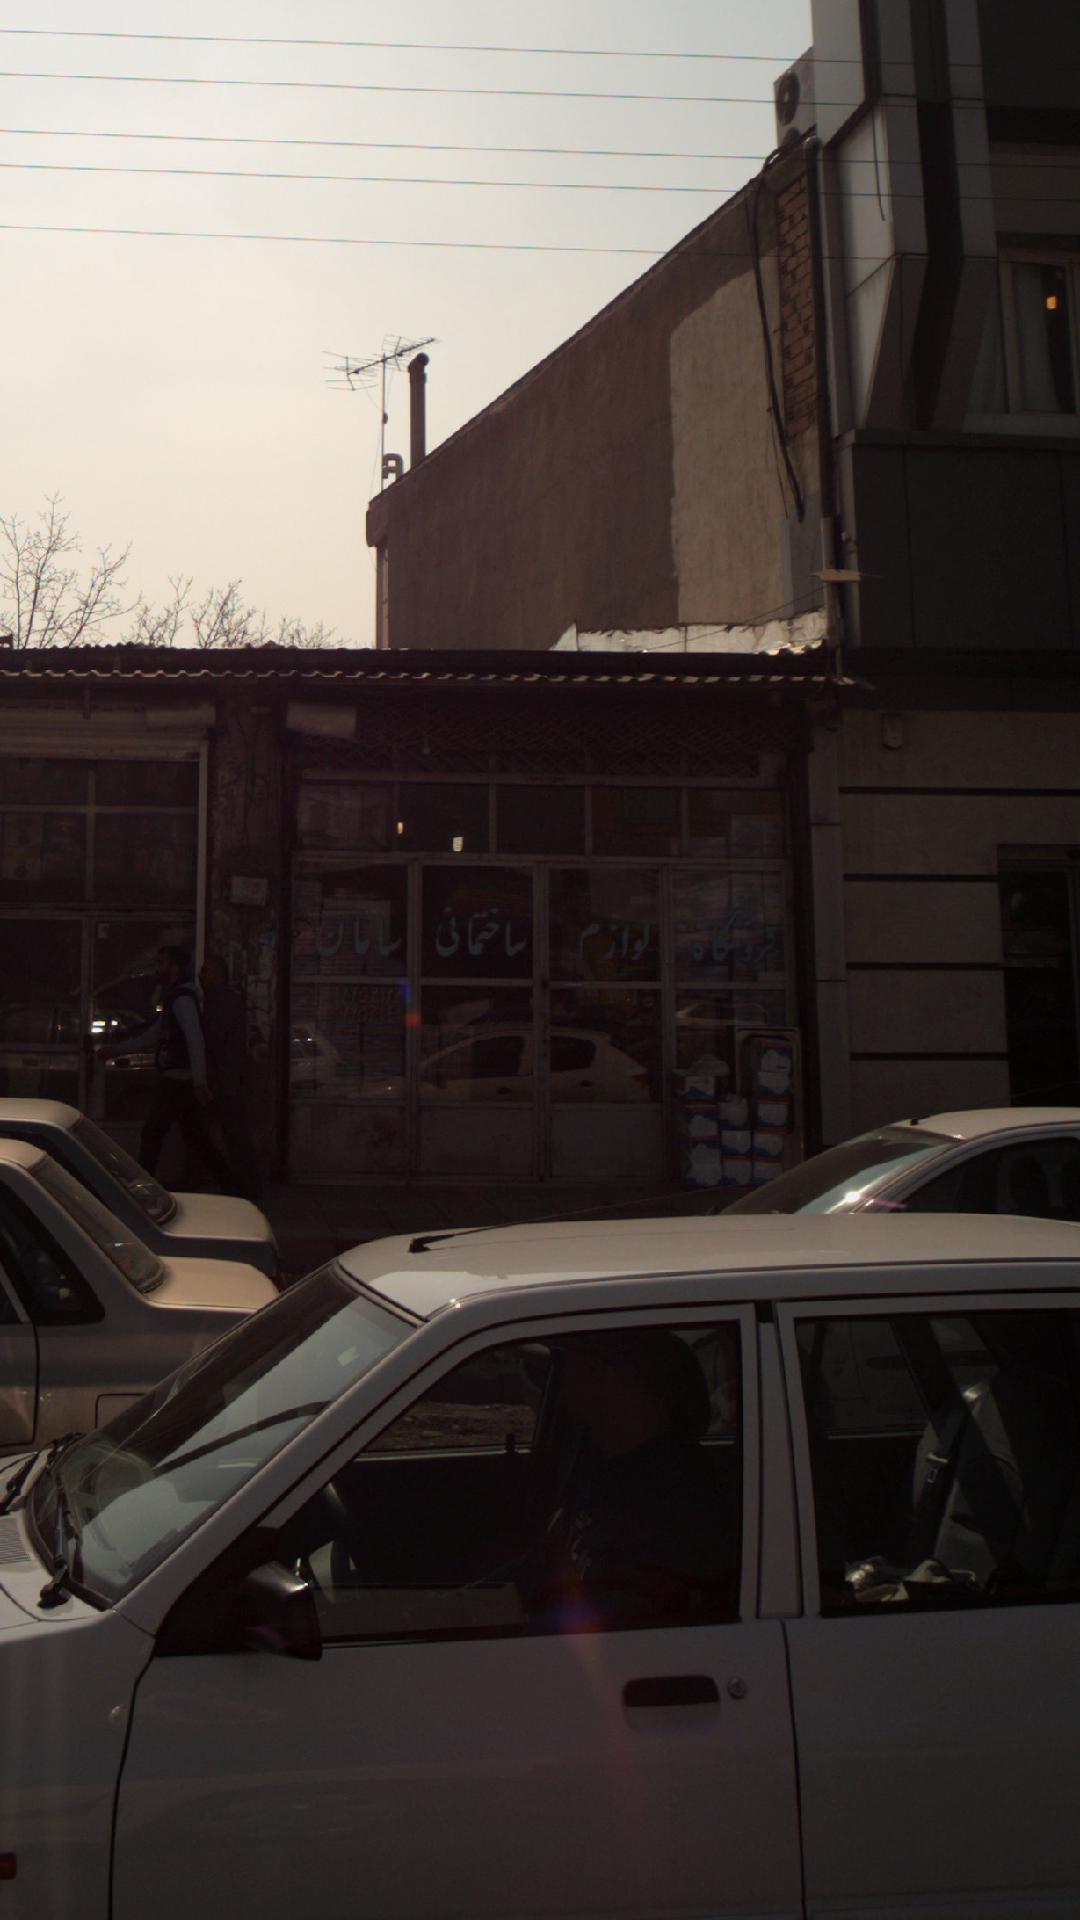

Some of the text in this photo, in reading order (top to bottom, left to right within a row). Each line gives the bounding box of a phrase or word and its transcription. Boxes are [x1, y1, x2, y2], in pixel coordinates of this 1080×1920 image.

[315, 911, 402, 957] سامان
[434, 905, 528, 957] ساختمانی
[575, 919, 652, 961] لوازم
